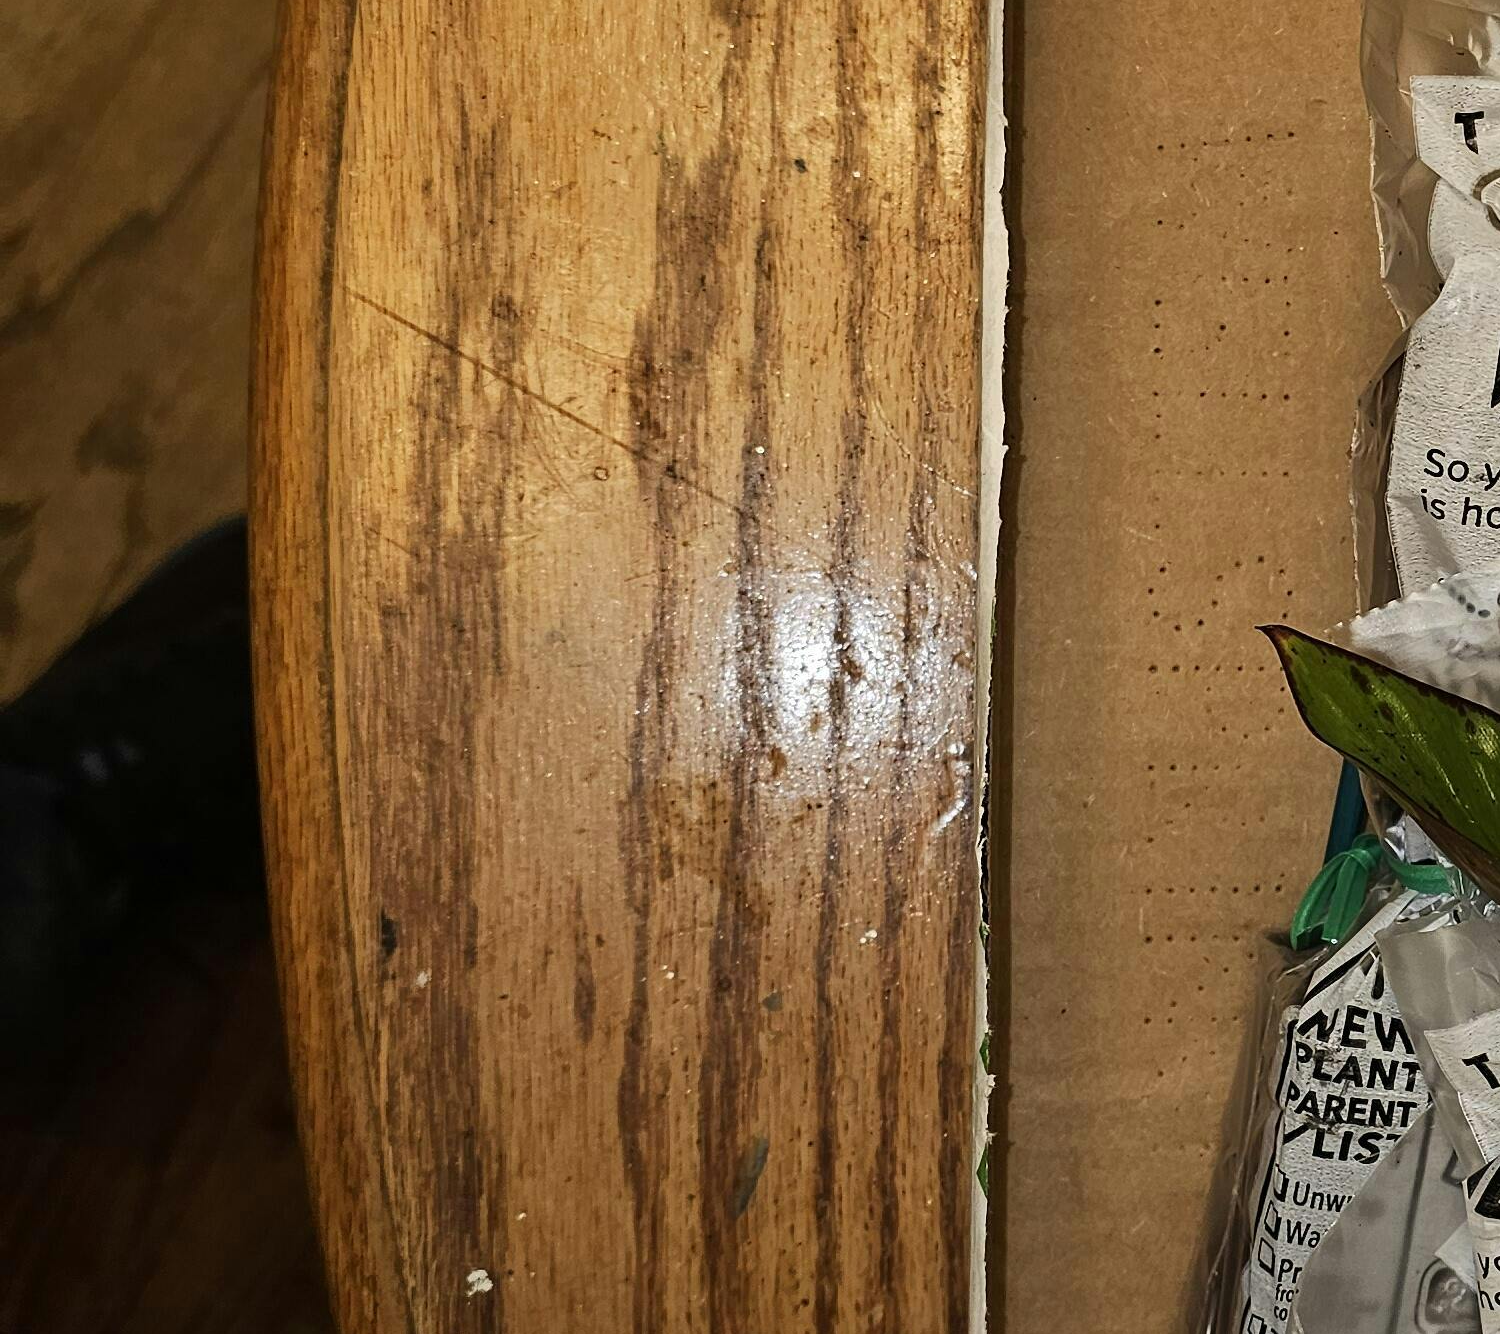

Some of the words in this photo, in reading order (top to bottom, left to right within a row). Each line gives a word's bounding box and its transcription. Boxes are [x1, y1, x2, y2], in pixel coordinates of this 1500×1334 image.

[1423, 448, 1471, 483] So
[1420, 488, 1446, 520] is
[1296, 1004, 1416, 1055] NEW
[1295, 1040, 1422, 1093] PLANT
[1284, 1079, 1418, 1129] PARENT
